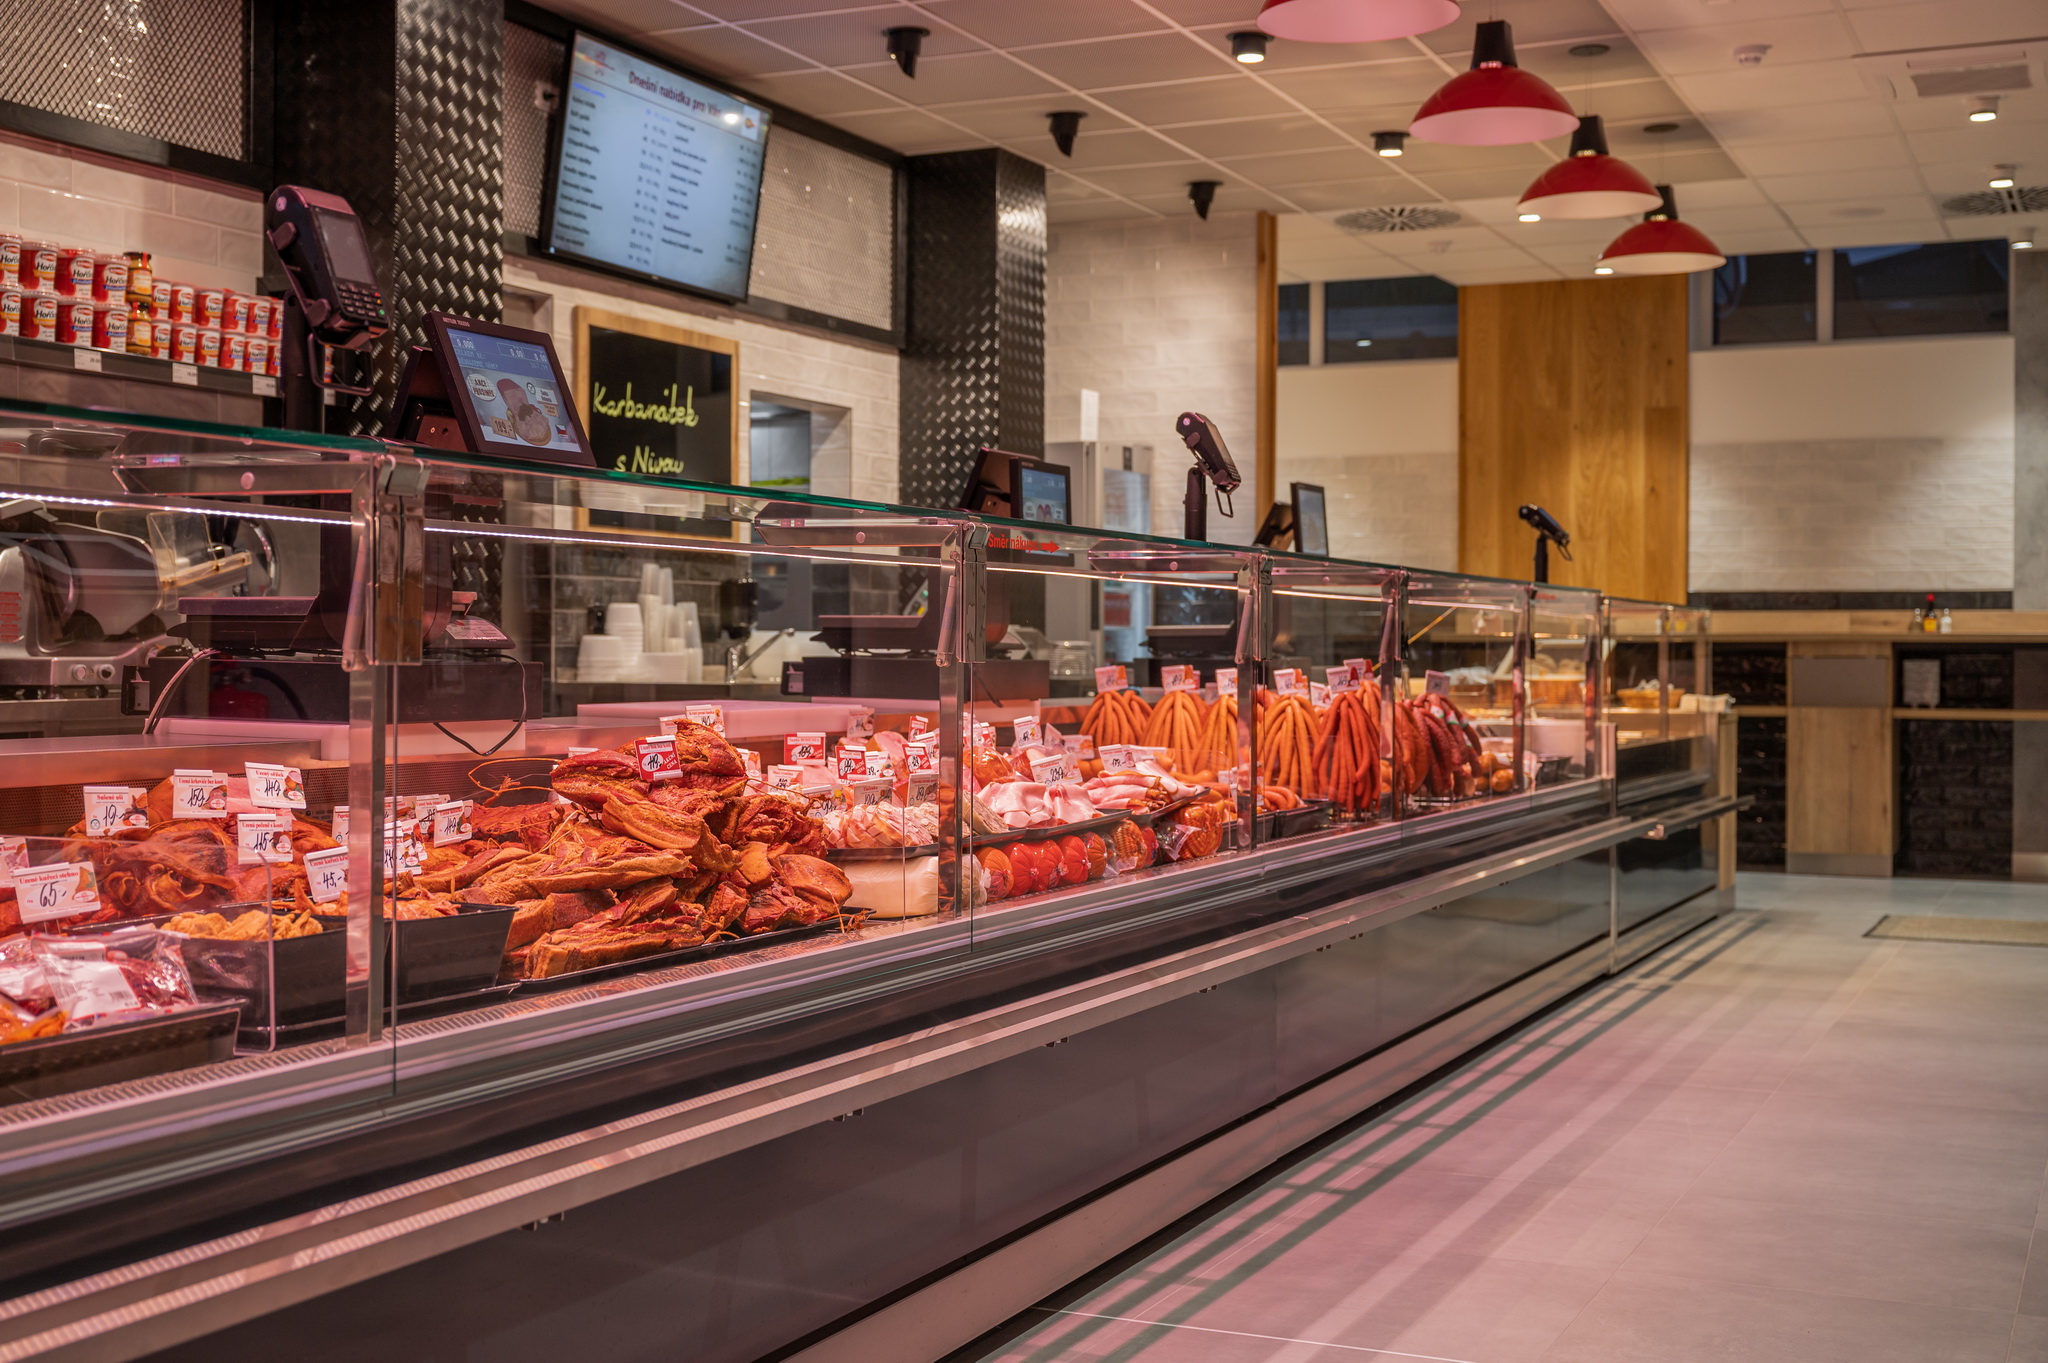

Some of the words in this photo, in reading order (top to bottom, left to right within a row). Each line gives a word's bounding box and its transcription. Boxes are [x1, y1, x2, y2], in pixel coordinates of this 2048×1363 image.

[631, 445, 684, 474] Nivou
[988, 533, 1009, 549] Směr
[1009, 536, 1039, 554] nákupu
[664, 752, 676, 764] AKČNÍ
[667, 759, 678, 769] CENA
[19, 876, 38, 884] Uzené
